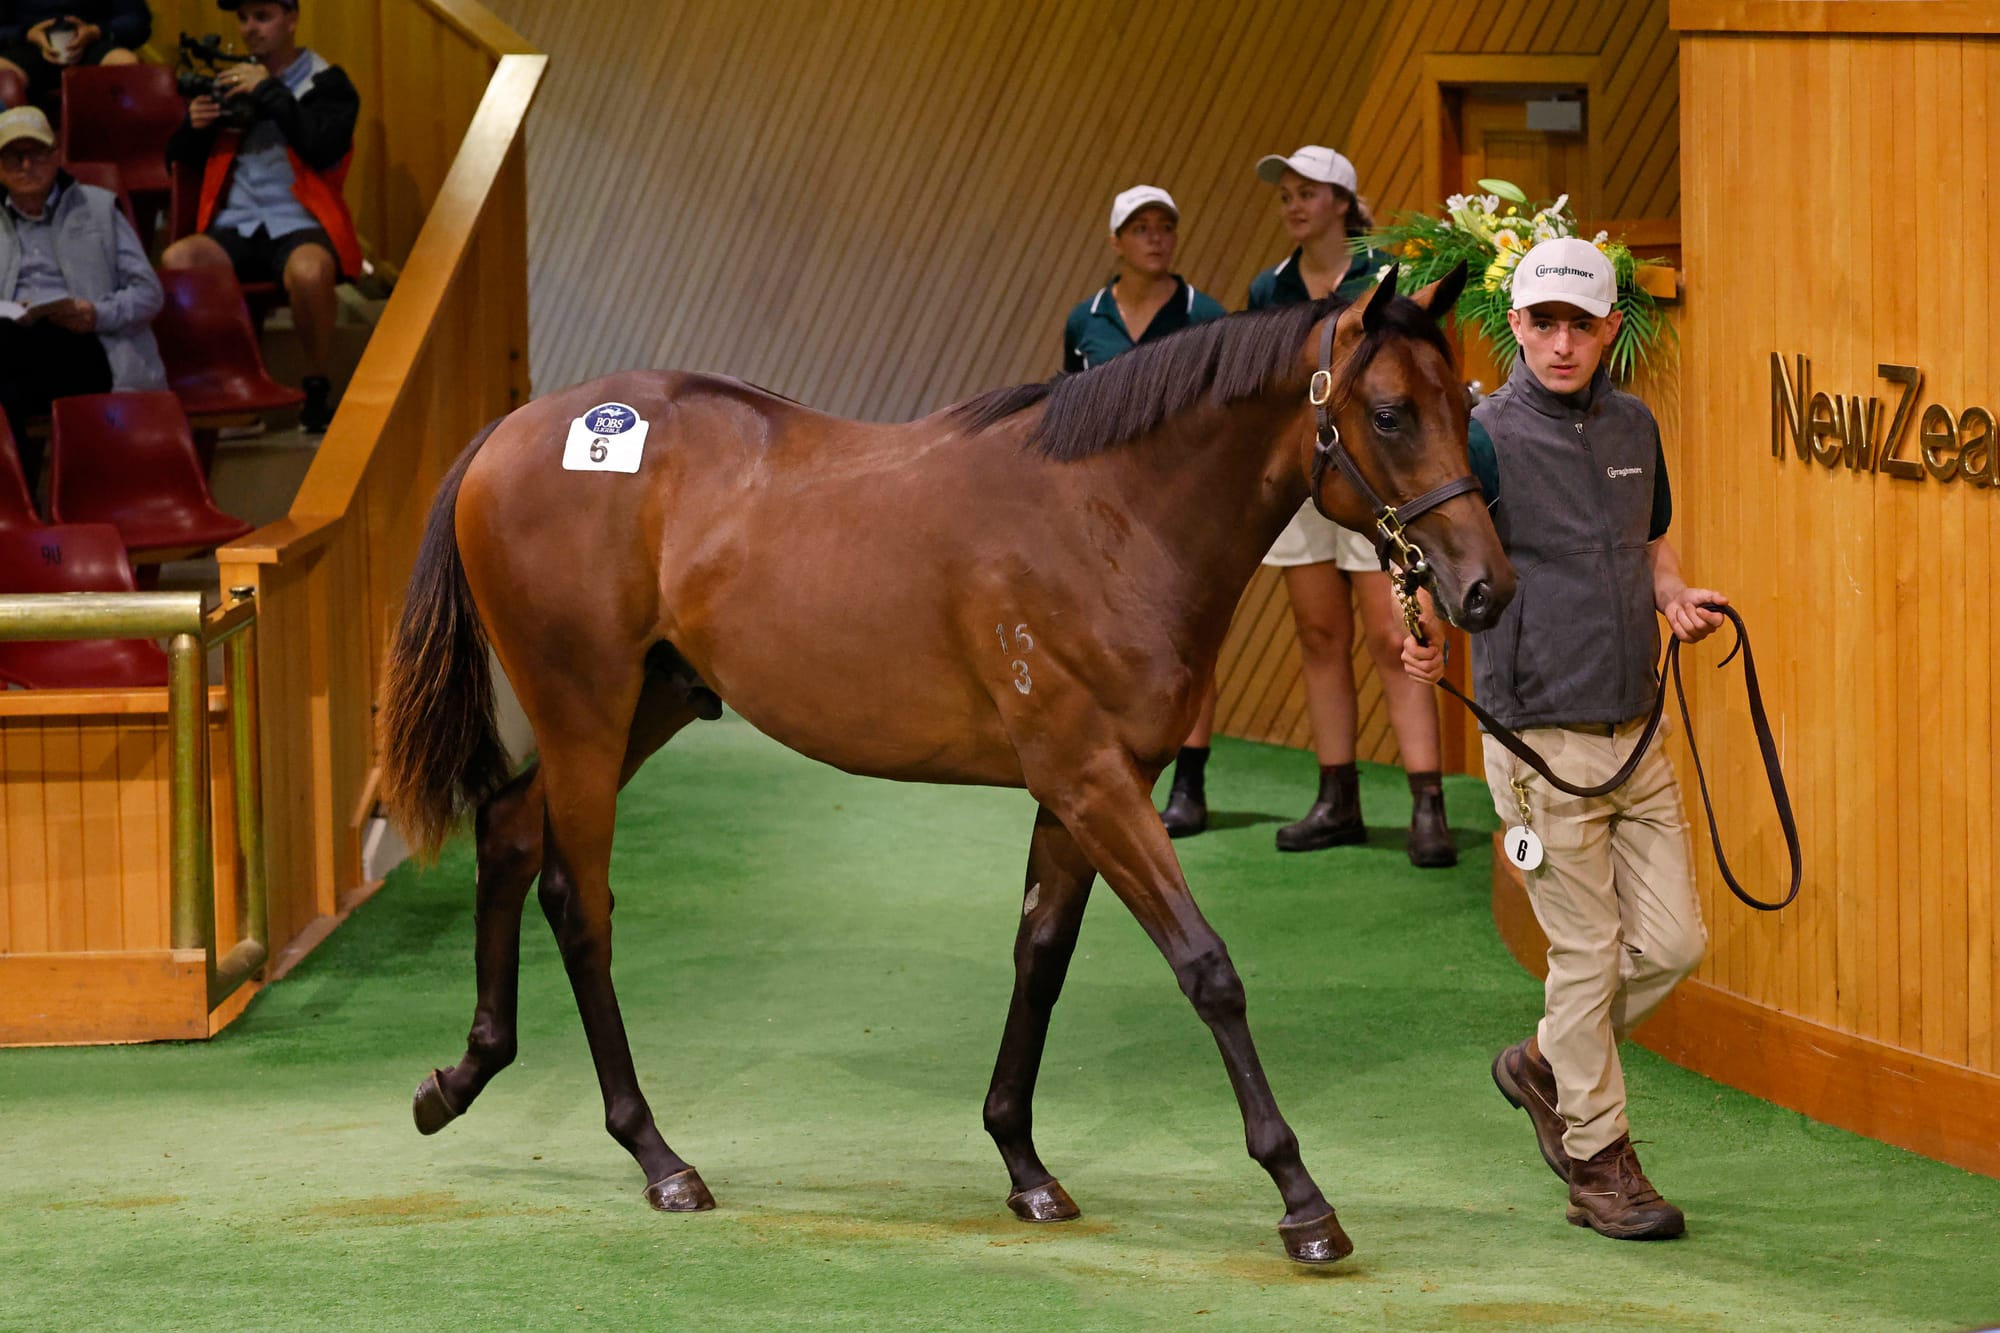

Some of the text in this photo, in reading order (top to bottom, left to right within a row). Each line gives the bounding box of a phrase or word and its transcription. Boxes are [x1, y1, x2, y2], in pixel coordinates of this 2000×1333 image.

[1535, 264, 1595, 279] Curraghmore
[594, 417, 625, 429] BOBS
[589, 437, 610, 463] 6
[1011, 659, 1032, 695] 3
[1516, 839, 1528, 862] 6
